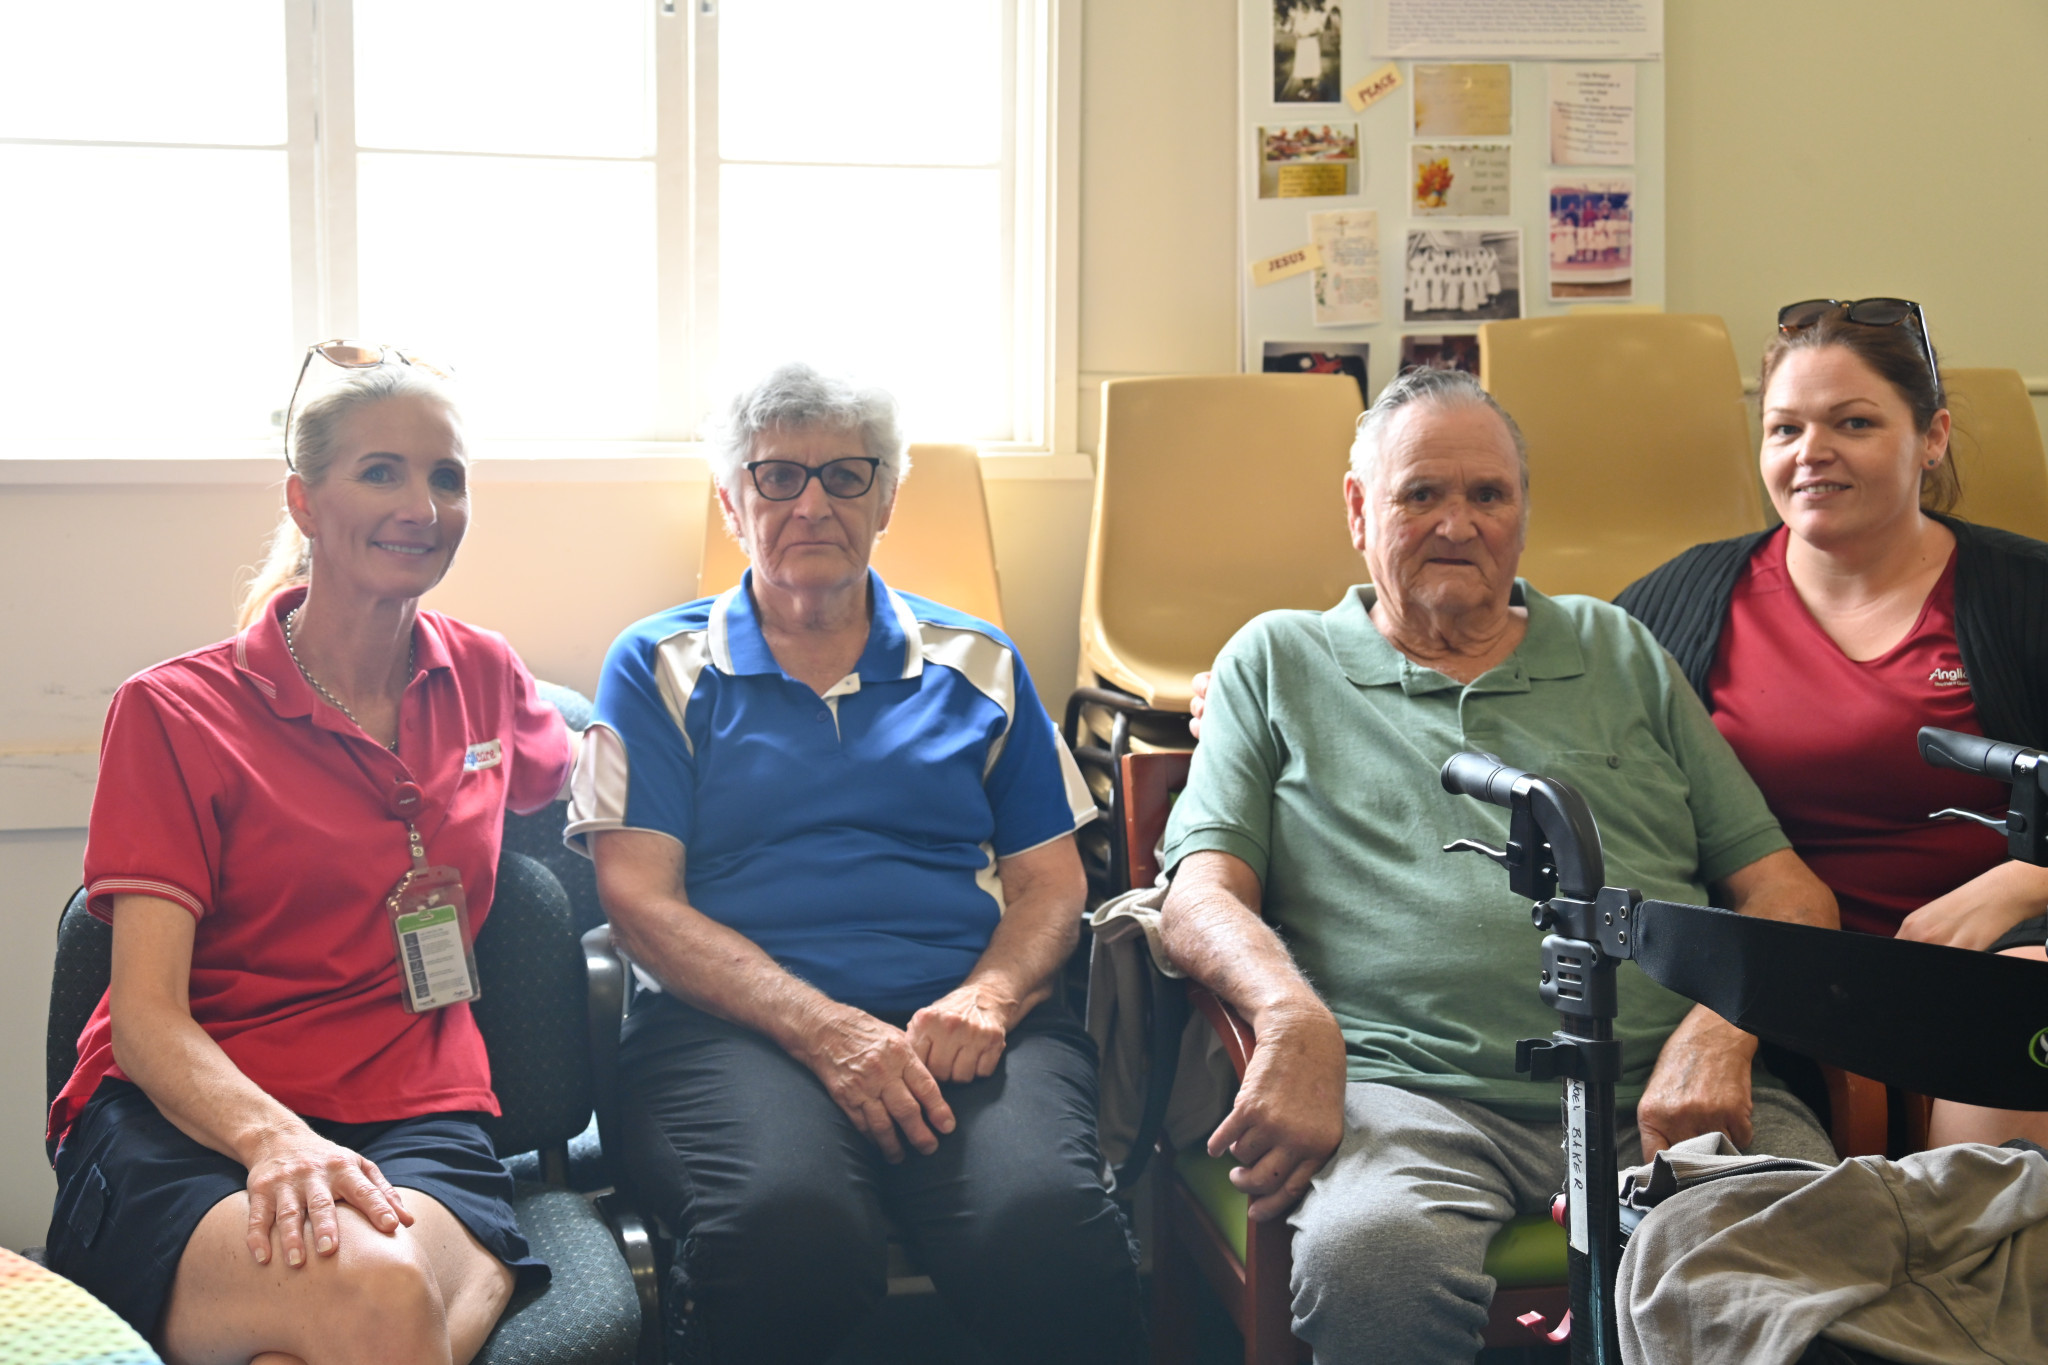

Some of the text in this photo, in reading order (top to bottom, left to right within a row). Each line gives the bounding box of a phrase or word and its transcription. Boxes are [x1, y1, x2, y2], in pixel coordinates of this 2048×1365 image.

[1358, 73, 1396, 104] PEACE
[1269, 251, 1306, 272] JESUS
[1572, 1127, 1583, 1190] BAKER
